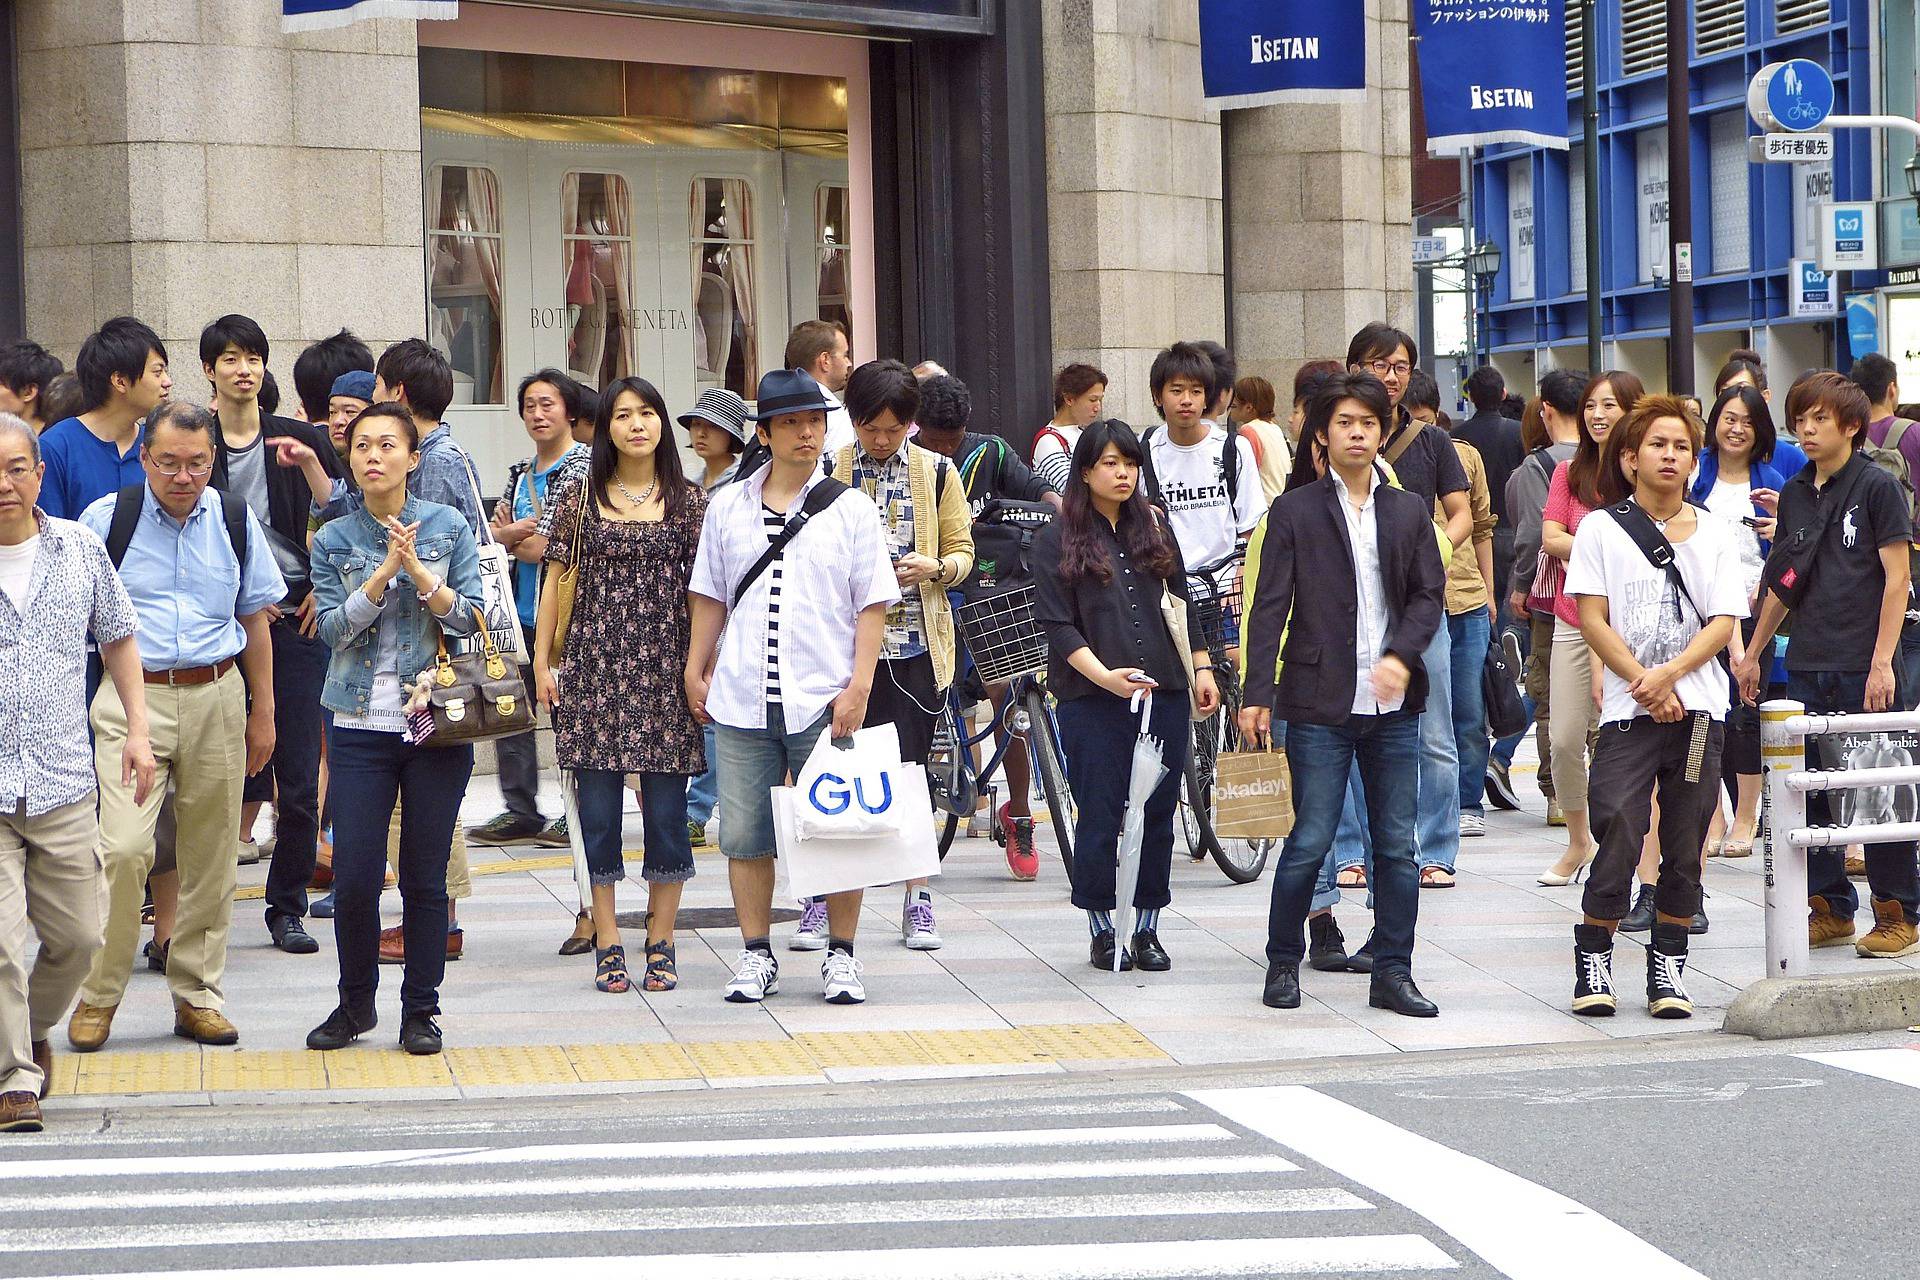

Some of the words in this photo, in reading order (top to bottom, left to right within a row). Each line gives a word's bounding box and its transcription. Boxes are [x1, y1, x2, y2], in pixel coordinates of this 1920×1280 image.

[1430, 7, 1550, 24] ファッションの伊勢丹
[1770, 140, 1829, 155] 歩行者優先
[1002, 512, 1052, 523] ATHLETA
[1624, 579, 1660, 601] ELVIS
[808, 771, 893, 816] GU
